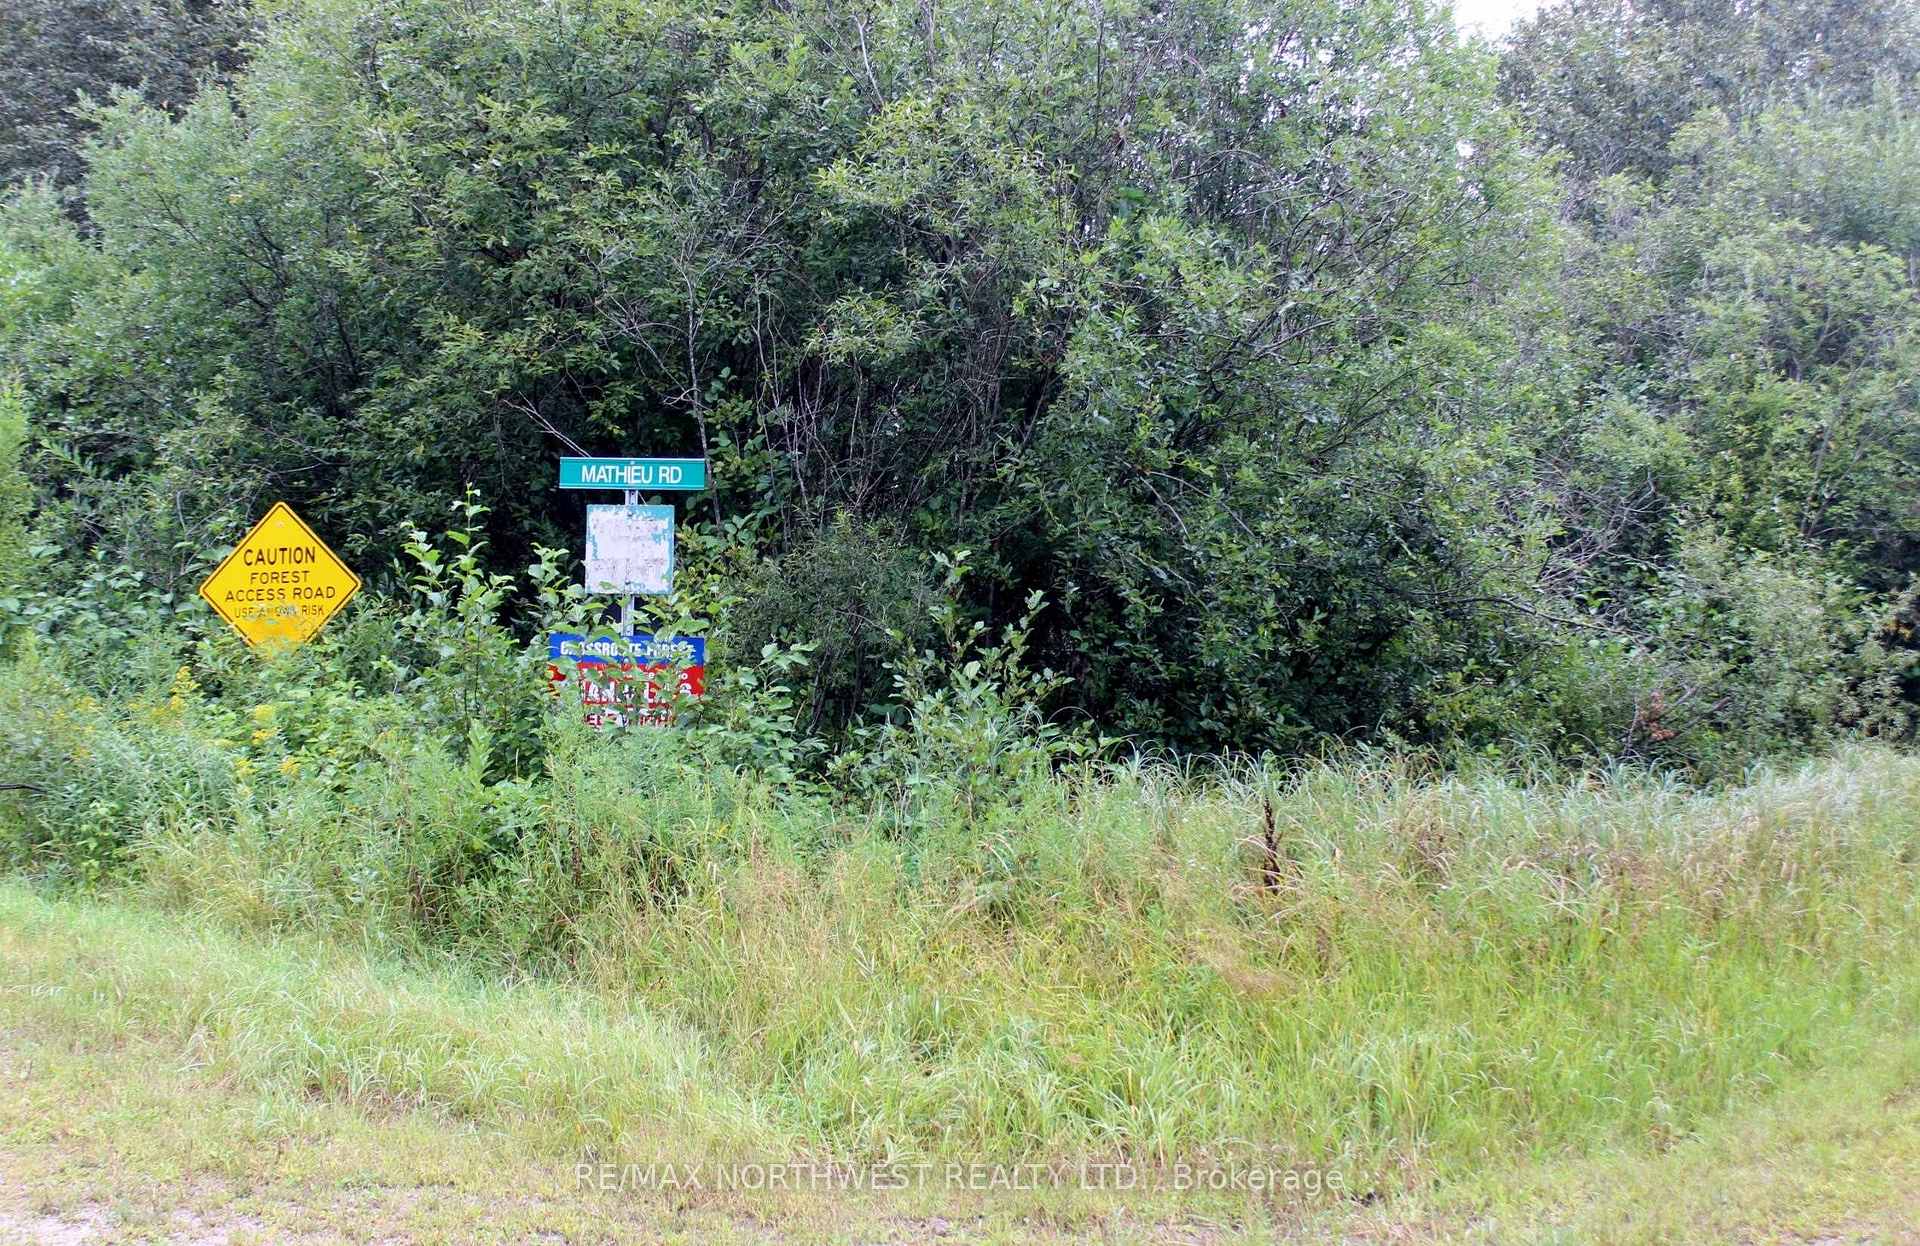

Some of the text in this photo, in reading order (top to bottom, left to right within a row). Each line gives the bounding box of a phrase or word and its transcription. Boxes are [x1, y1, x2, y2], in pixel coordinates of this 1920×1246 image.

[581, 465, 682, 484] MATHIEU RD
[243, 546, 316, 566] CAUTION
[250, 570, 310, 585] FOREST
[225, 586, 336, 602] ACCESS ROAD
[235, 607, 254, 619] USE
[301, 604, 325, 616] RISK
